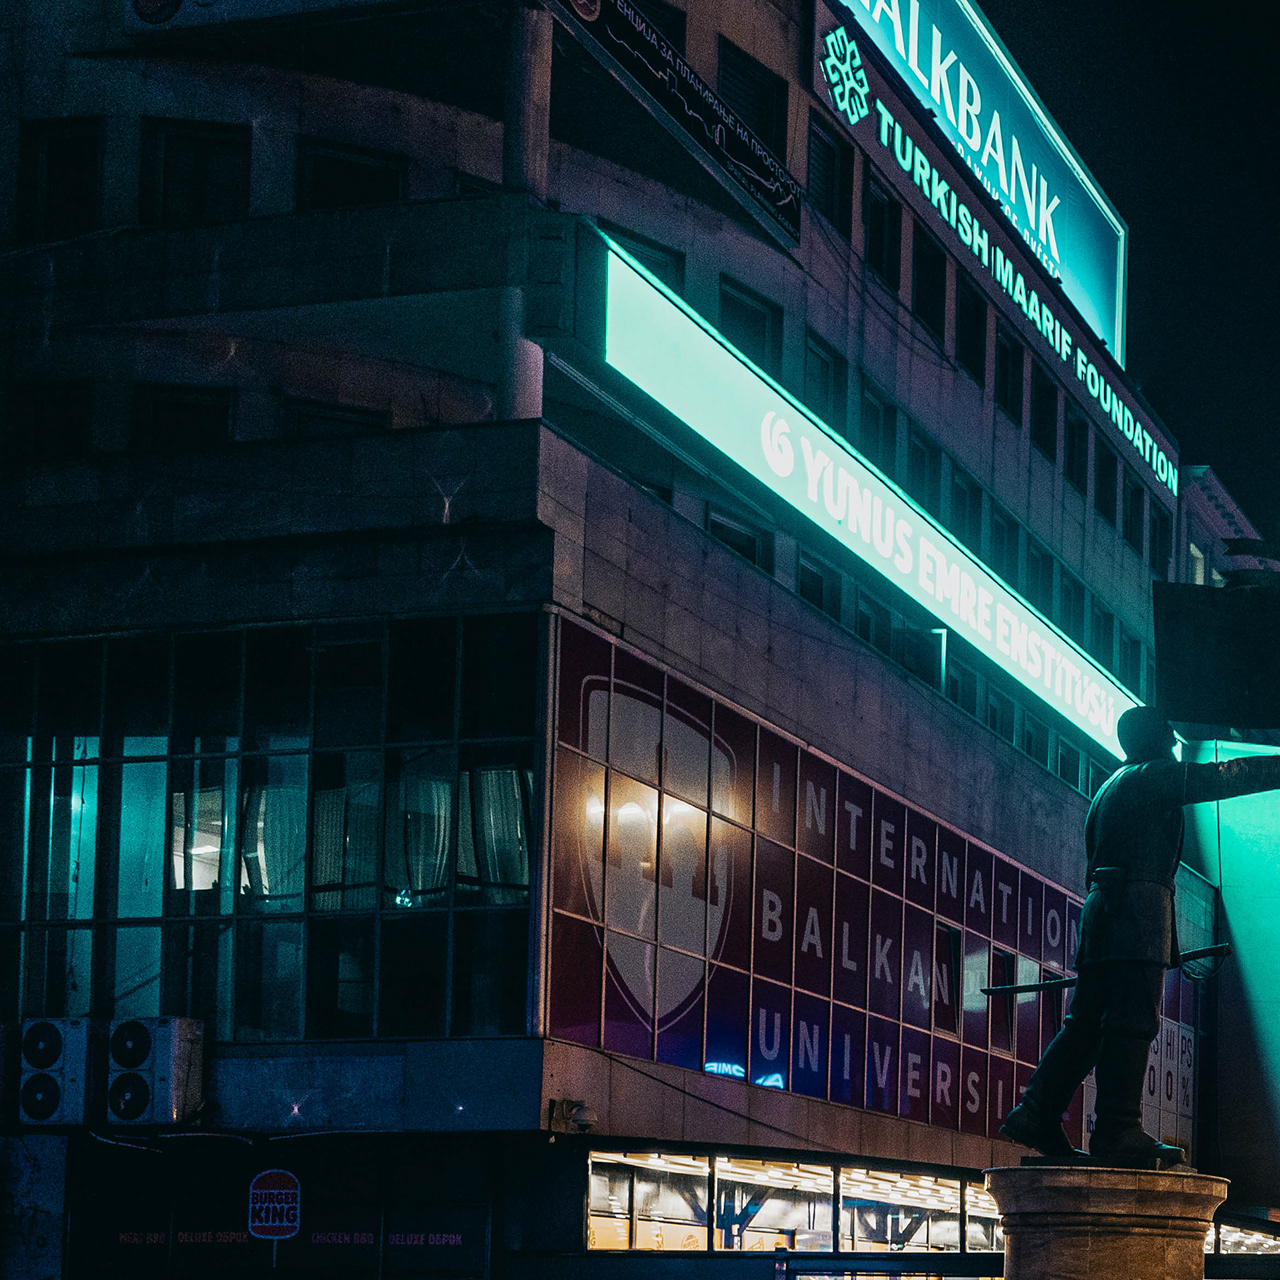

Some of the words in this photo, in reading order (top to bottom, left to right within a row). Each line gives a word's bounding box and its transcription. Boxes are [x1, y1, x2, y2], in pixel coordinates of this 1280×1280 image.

[852, 0, 1061, 265] ALKBANK
[876, 98, 989, 268] TURKISH
[995, 246, 1073, 364] MAARIF
[1076, 346, 1179, 497] FOUNDATION
[800, 435, 913, 575] YUNUS
[918, 536, 994, 643] EMRE
[761, 889, 950, 1005] BALKAN
[251, 1192, 298, 1205] BURGER
[251, 1205, 298, 1224] KING
[177, 1231, 213, 1244] DELUXE
[311, 1232, 351, 1245] CHICKEN
[388, 1233, 425, 1246] DELUXE
